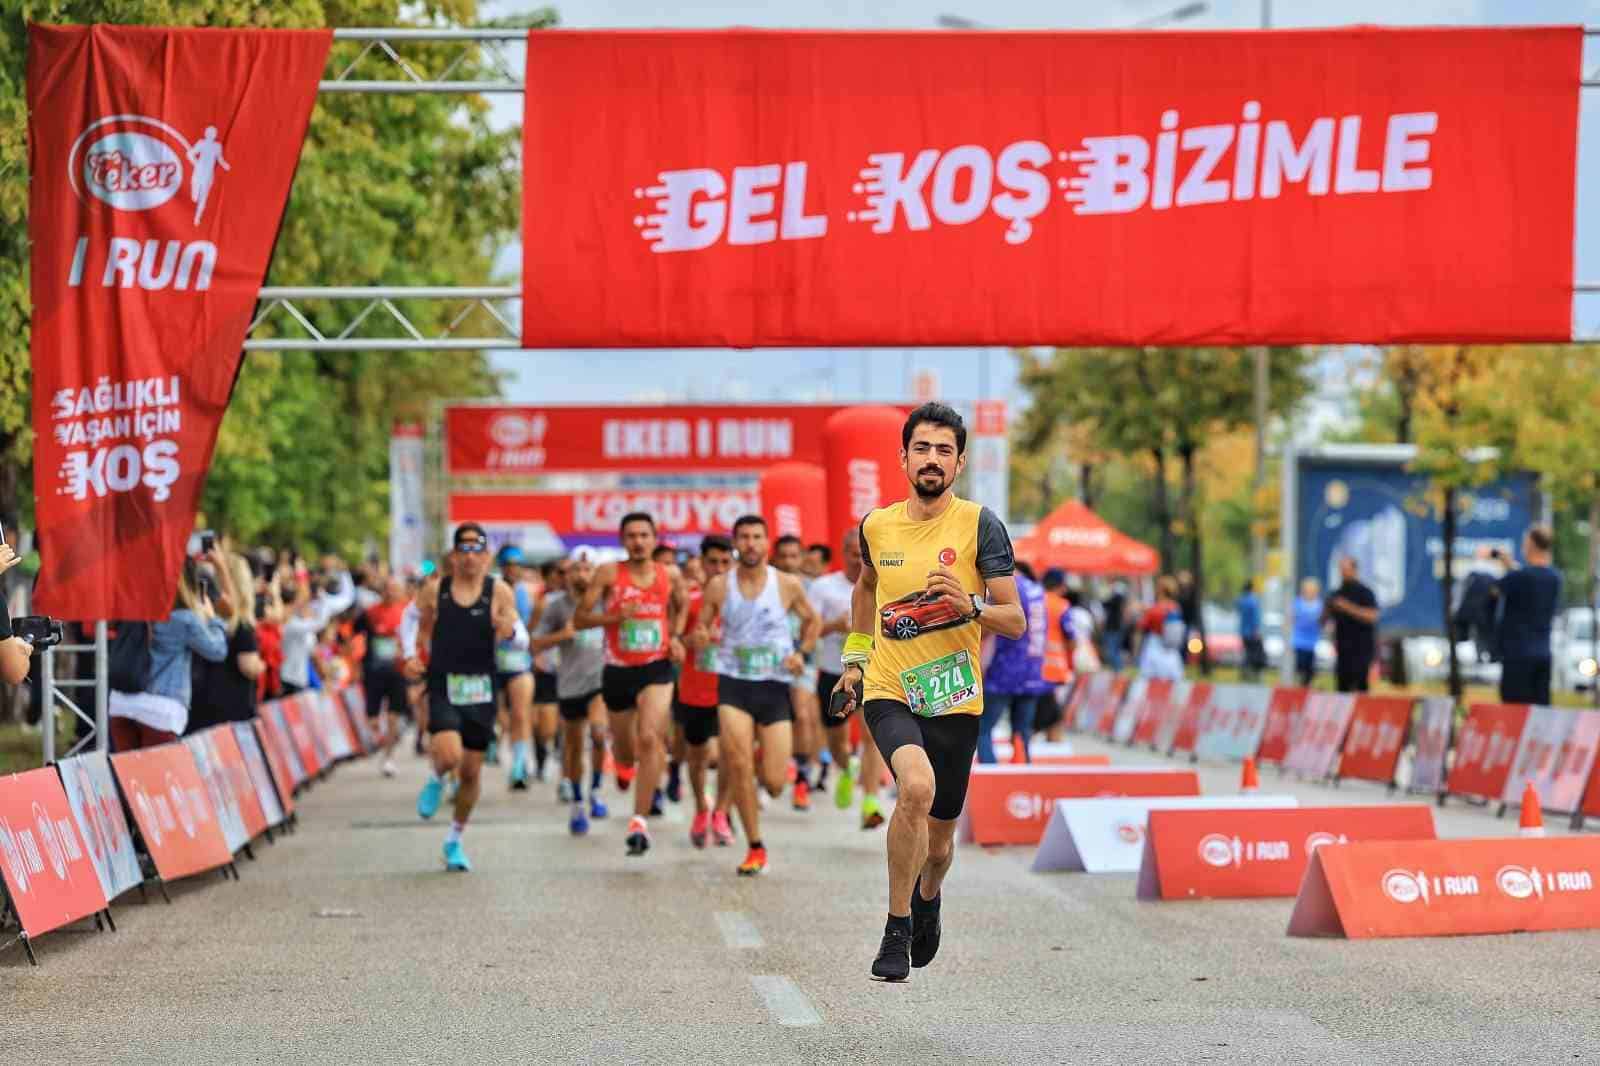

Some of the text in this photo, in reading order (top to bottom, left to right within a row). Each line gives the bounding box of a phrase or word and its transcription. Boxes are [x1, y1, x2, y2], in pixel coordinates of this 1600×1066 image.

[634, 101, 1439, 253] GEL KOŞ BİZİMLE
[68, 237, 217, 291] I RUN
[52, 375, 180, 420] SAĞLIKLI
[134, 406, 180, 441] İÇİN
[602, 418, 793, 458] EKER I RUN
[57, 439, 181, 502] KOŞ
[929, 665, 965, 699] 274
[1443, 876, 1480, 895] RUN
[1557, 871, 1592, 890] RUN
